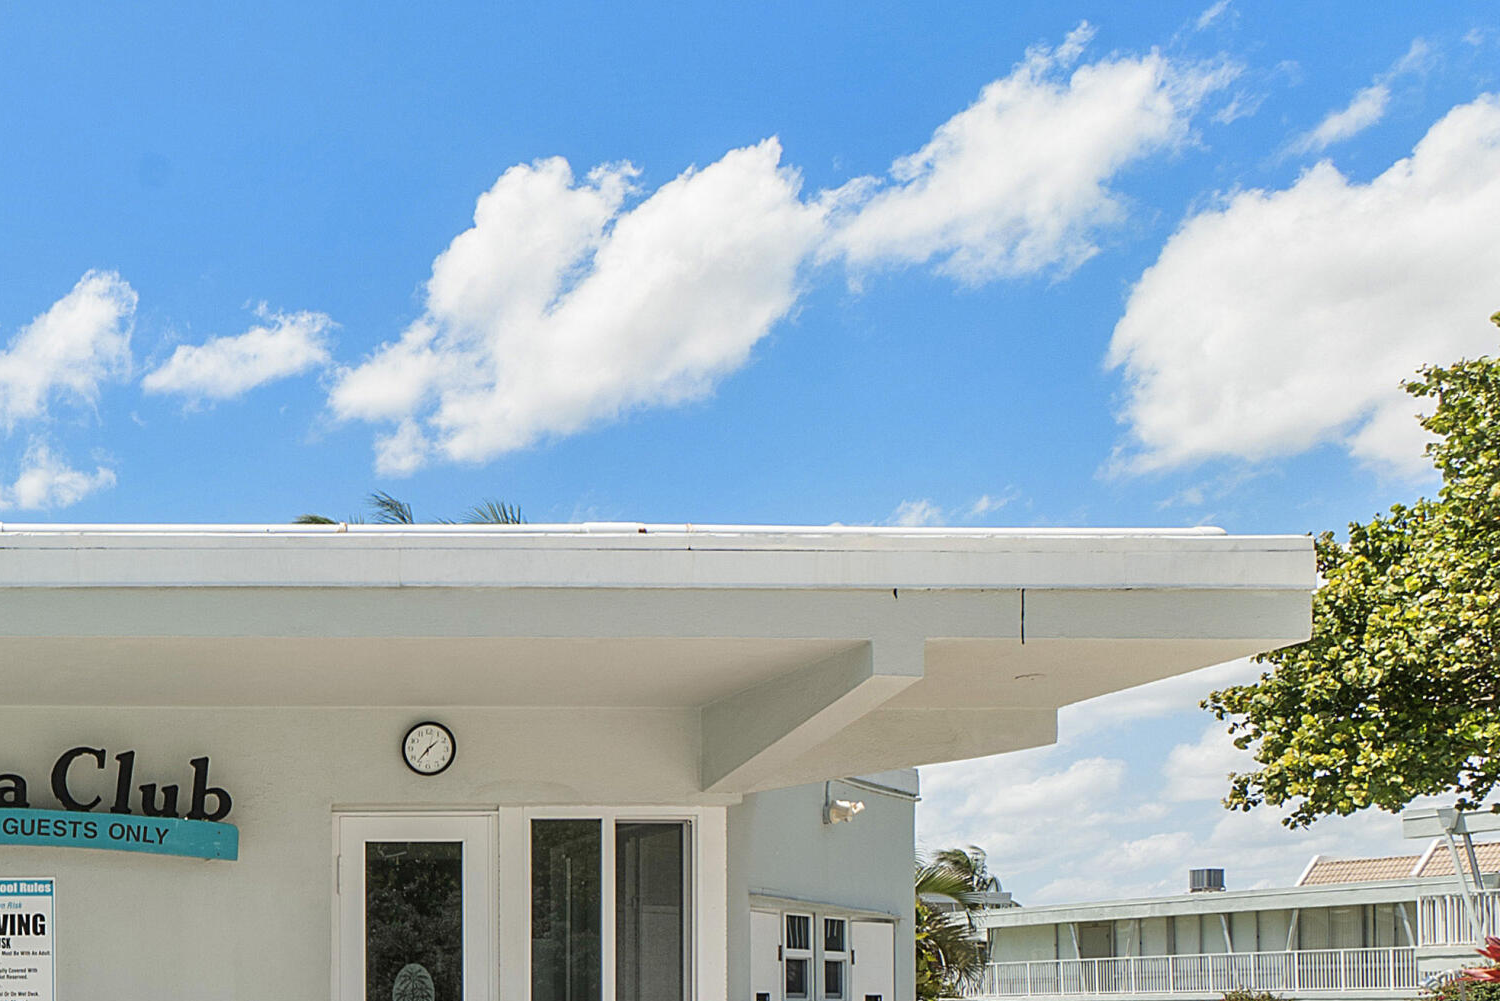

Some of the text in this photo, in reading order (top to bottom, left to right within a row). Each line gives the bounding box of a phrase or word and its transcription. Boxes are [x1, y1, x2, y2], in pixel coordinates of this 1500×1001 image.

[51, 747, 232, 822] Club
[2, 817, 98, 839] GUESTS
[108, 823, 169, 845] ONLY
[20, 882, 52, 893] Rules
[6, 902, 22, 910] Risk
